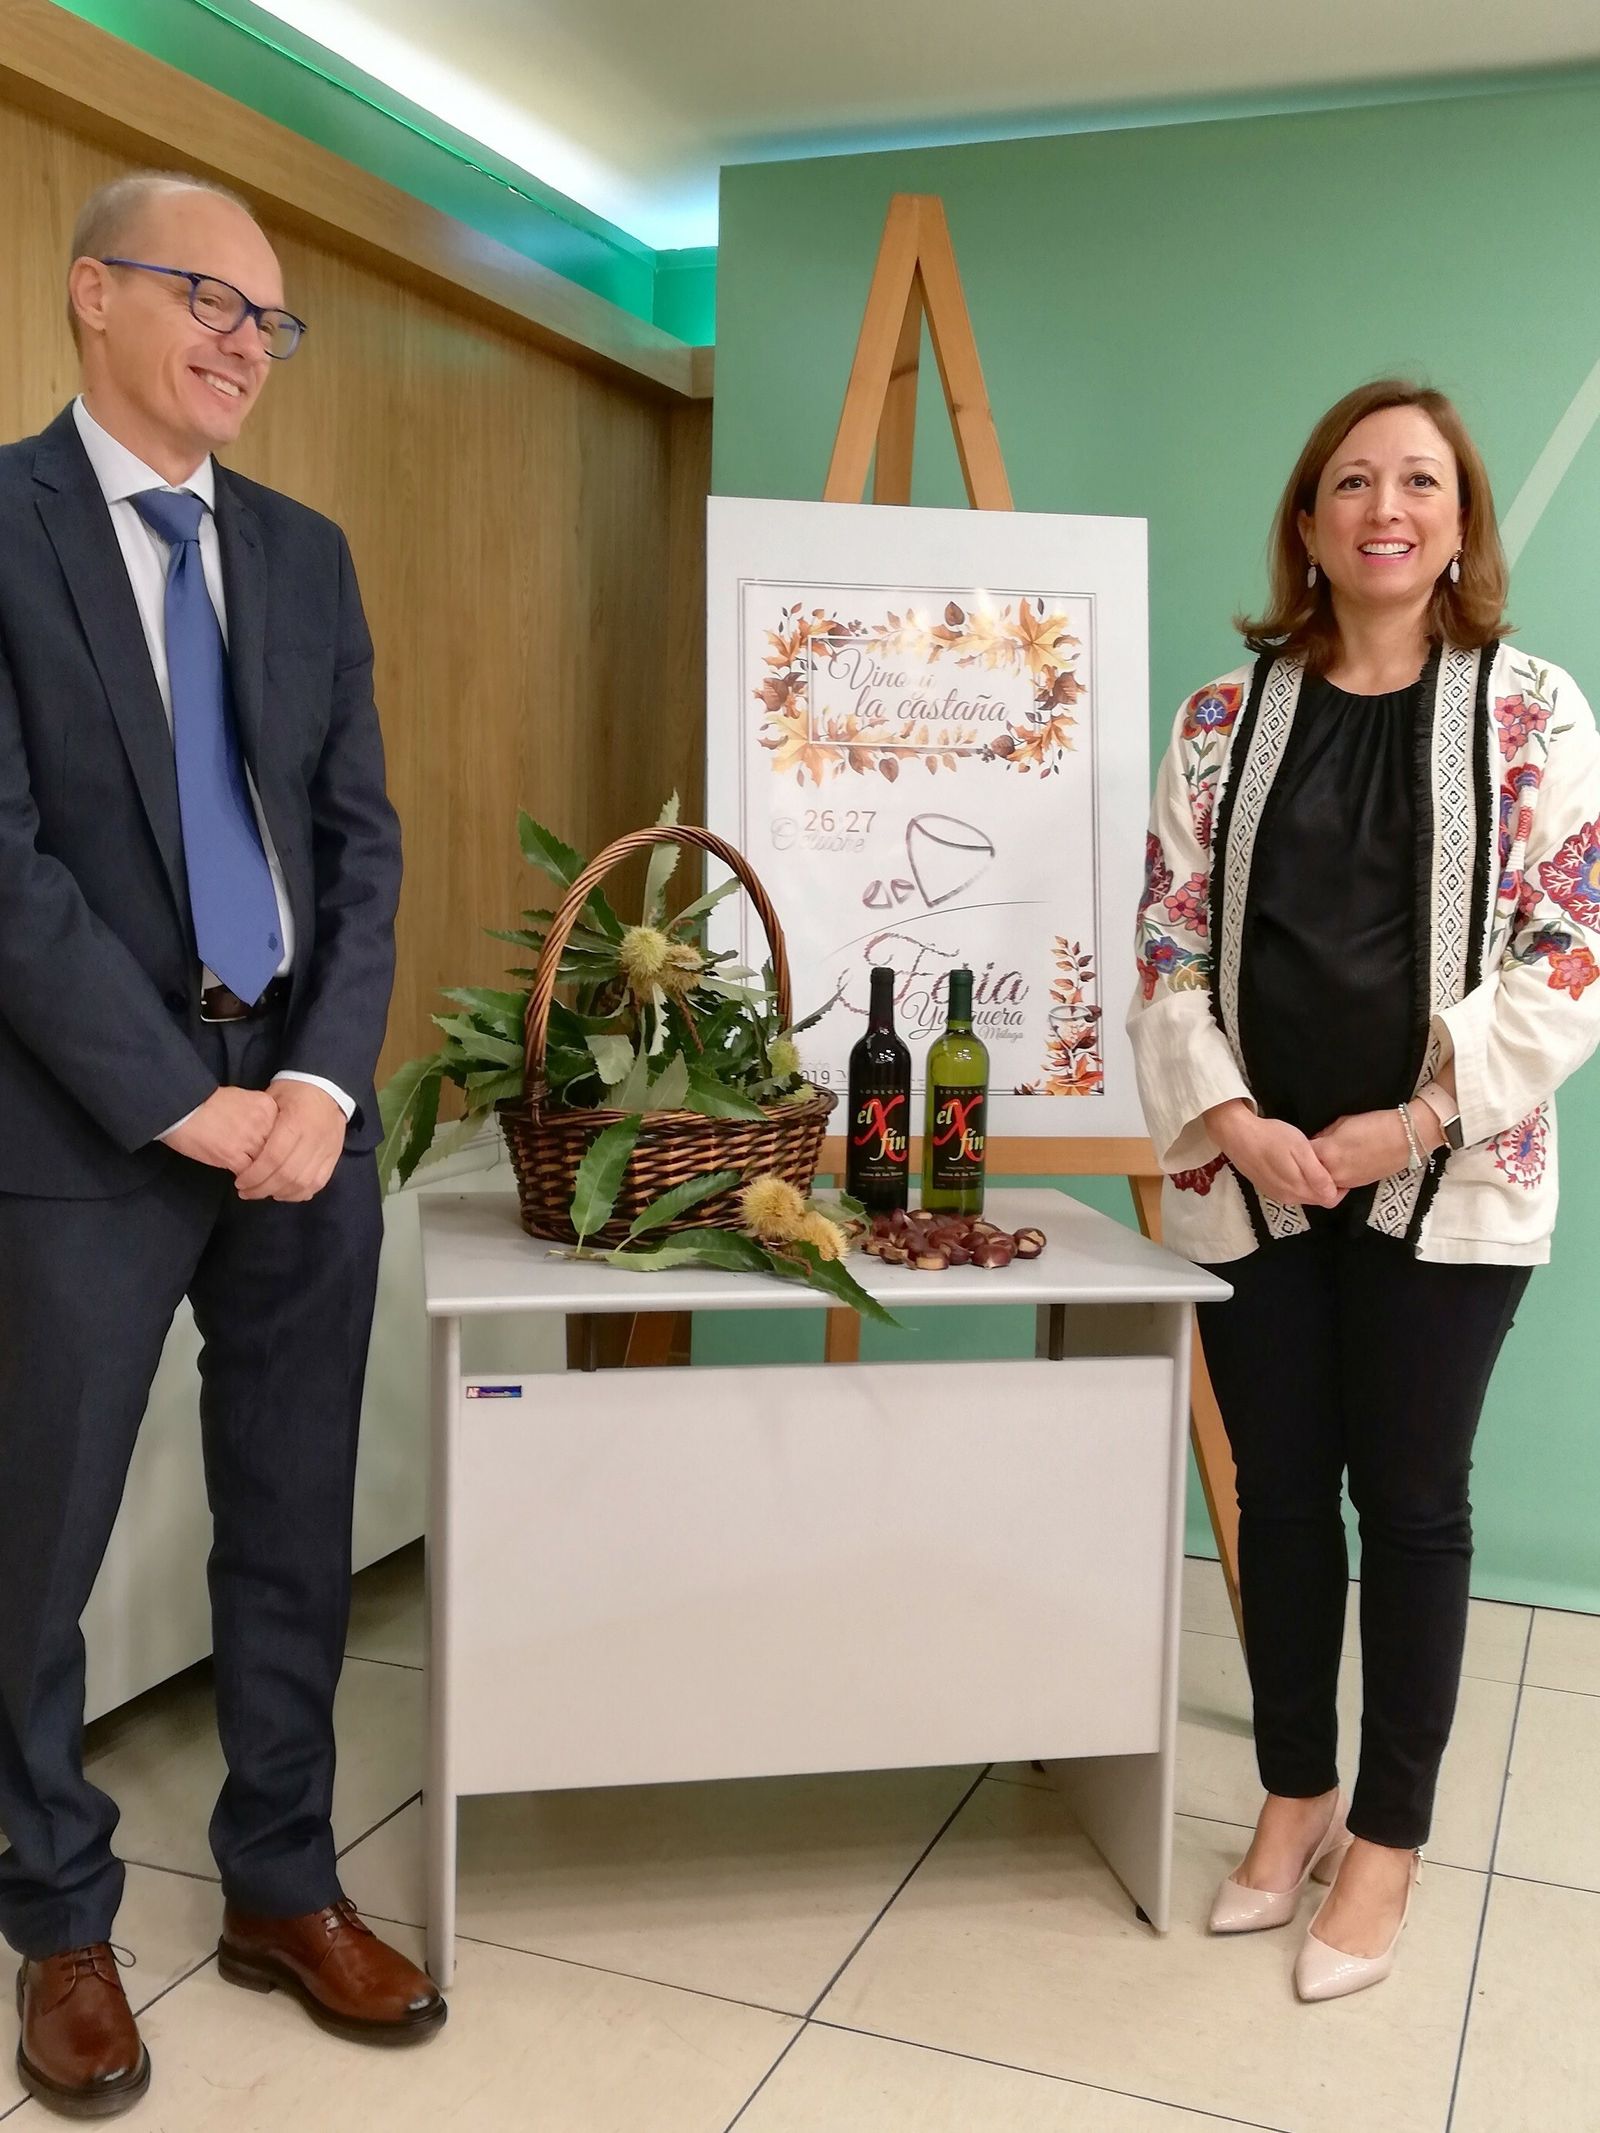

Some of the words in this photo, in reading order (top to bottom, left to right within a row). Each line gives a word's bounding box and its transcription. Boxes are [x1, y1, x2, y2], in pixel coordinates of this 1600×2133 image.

[829, 648, 909, 690] Vino
[855, 685, 886, 718] la
[897, 687, 1008, 722] castaña
[804, 809, 835, 832] 26
[845, 810, 877, 833] 27
[857, 1102, 877, 1125] el
[936, 1102, 958, 1125] el
